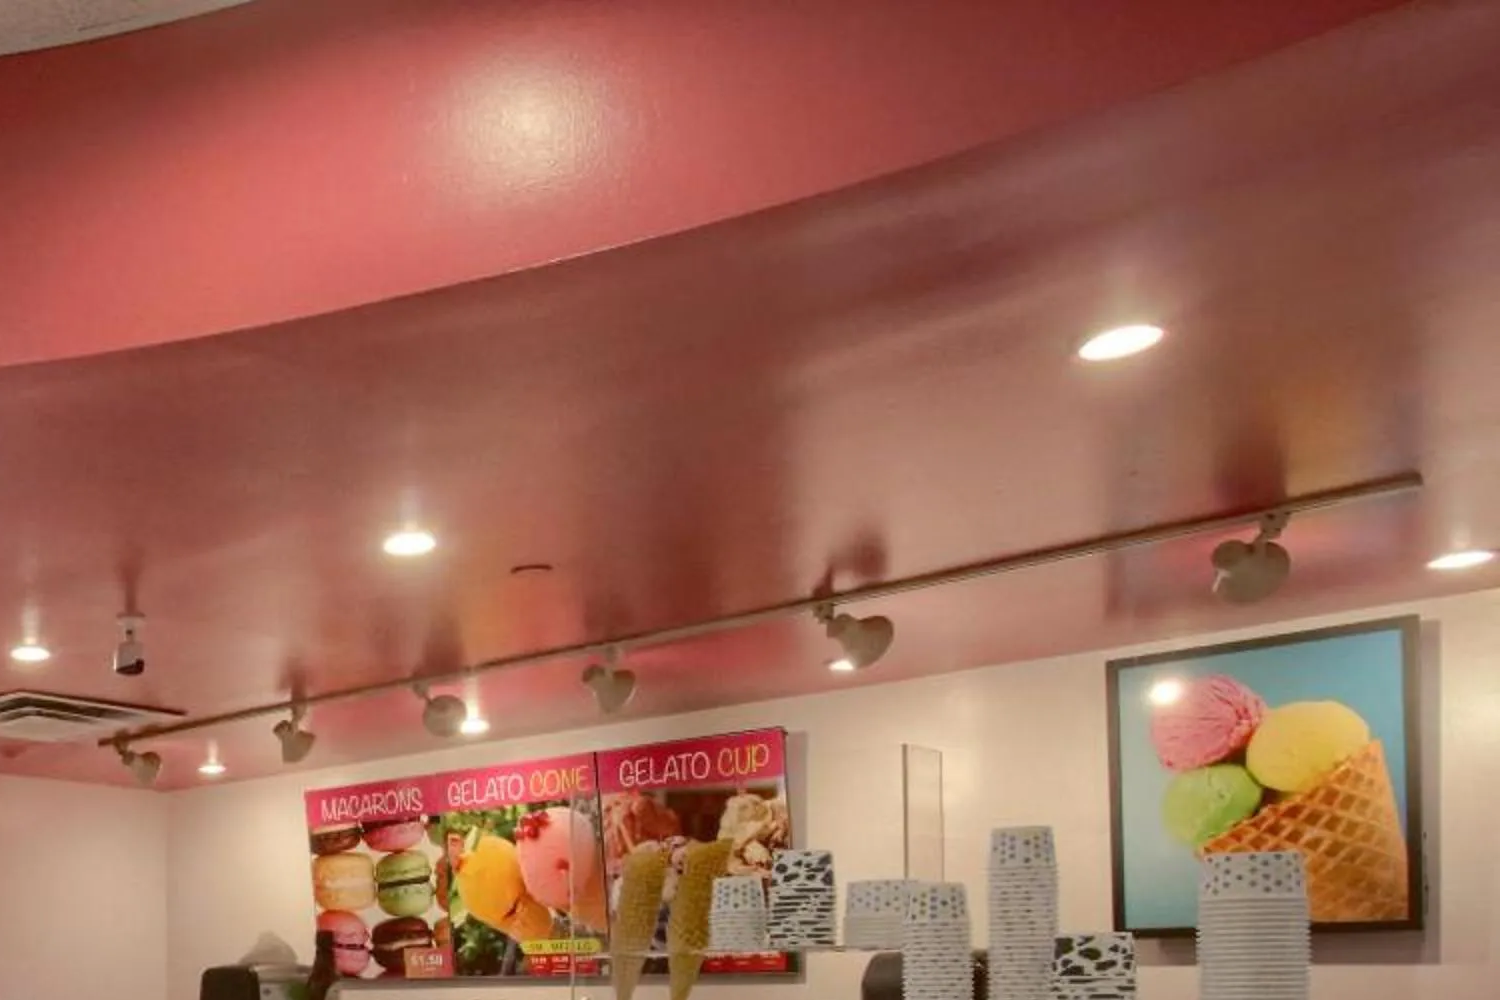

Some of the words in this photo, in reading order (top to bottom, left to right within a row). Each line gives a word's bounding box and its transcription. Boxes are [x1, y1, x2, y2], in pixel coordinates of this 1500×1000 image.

[447, 772, 524, 807] GELATO
[529, 764, 589, 797] CONE
[619, 751, 711, 788] GELATO
[717, 743, 769, 778] CUP
[320, 786, 423, 821] MACARONS
